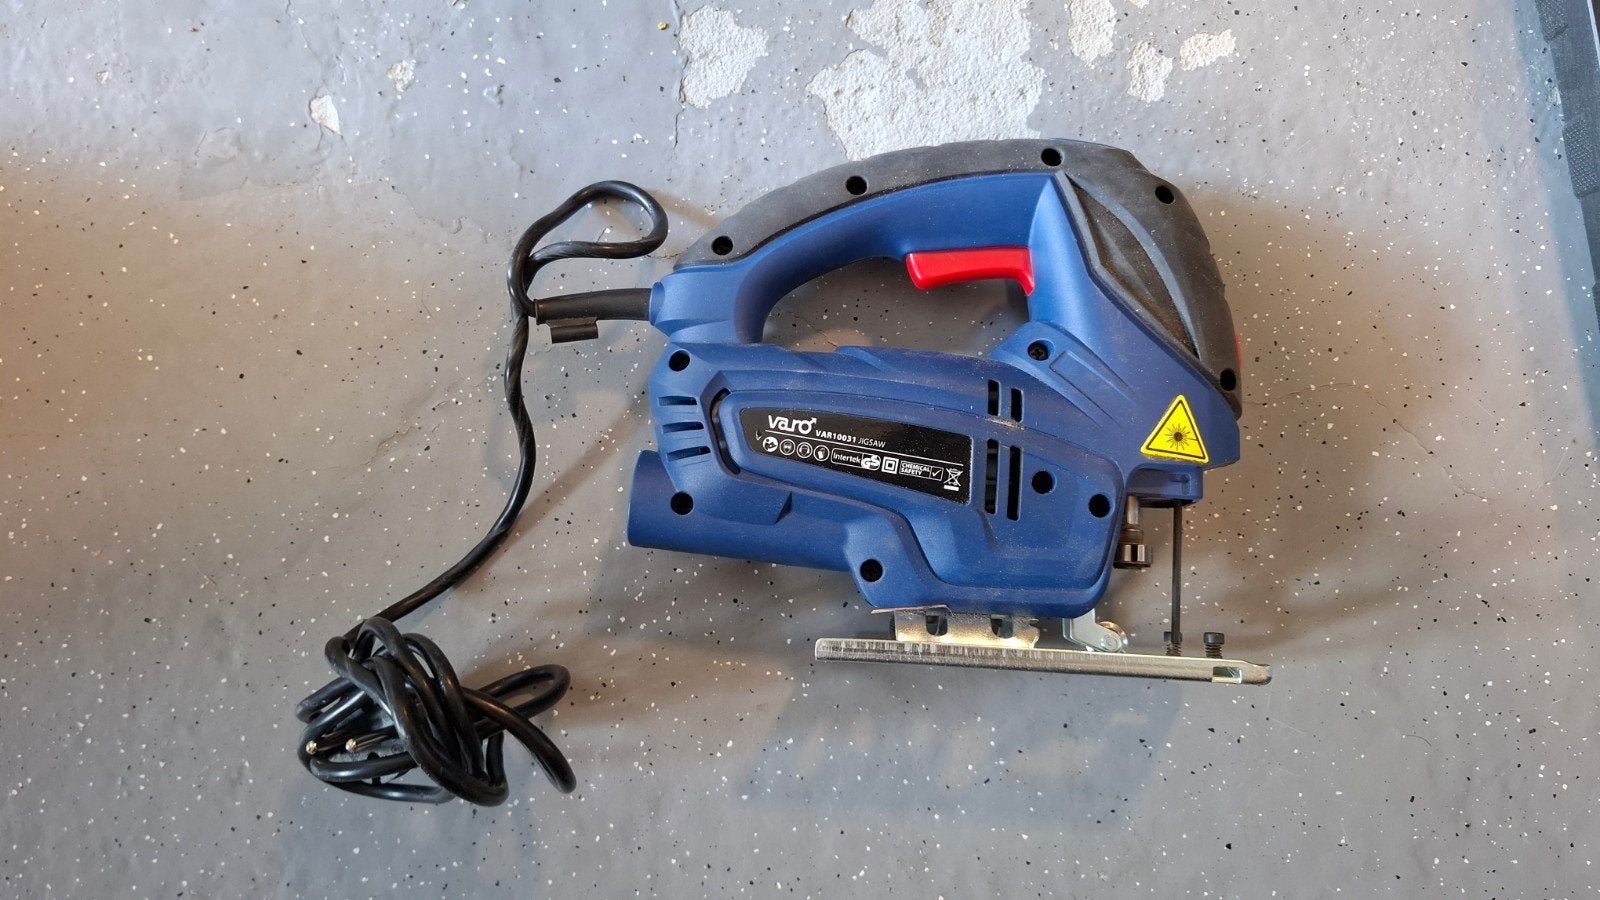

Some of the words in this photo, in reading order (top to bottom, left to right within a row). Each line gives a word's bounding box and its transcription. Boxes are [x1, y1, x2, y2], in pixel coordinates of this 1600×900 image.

[815, 429, 857, 443] VAR10031
[858, 437, 886, 448] JIGSAW
[833, 452, 861, 464] Intertek
[901, 462, 930, 472] CHEMICAL
[901, 467, 922, 476] SAFETY
